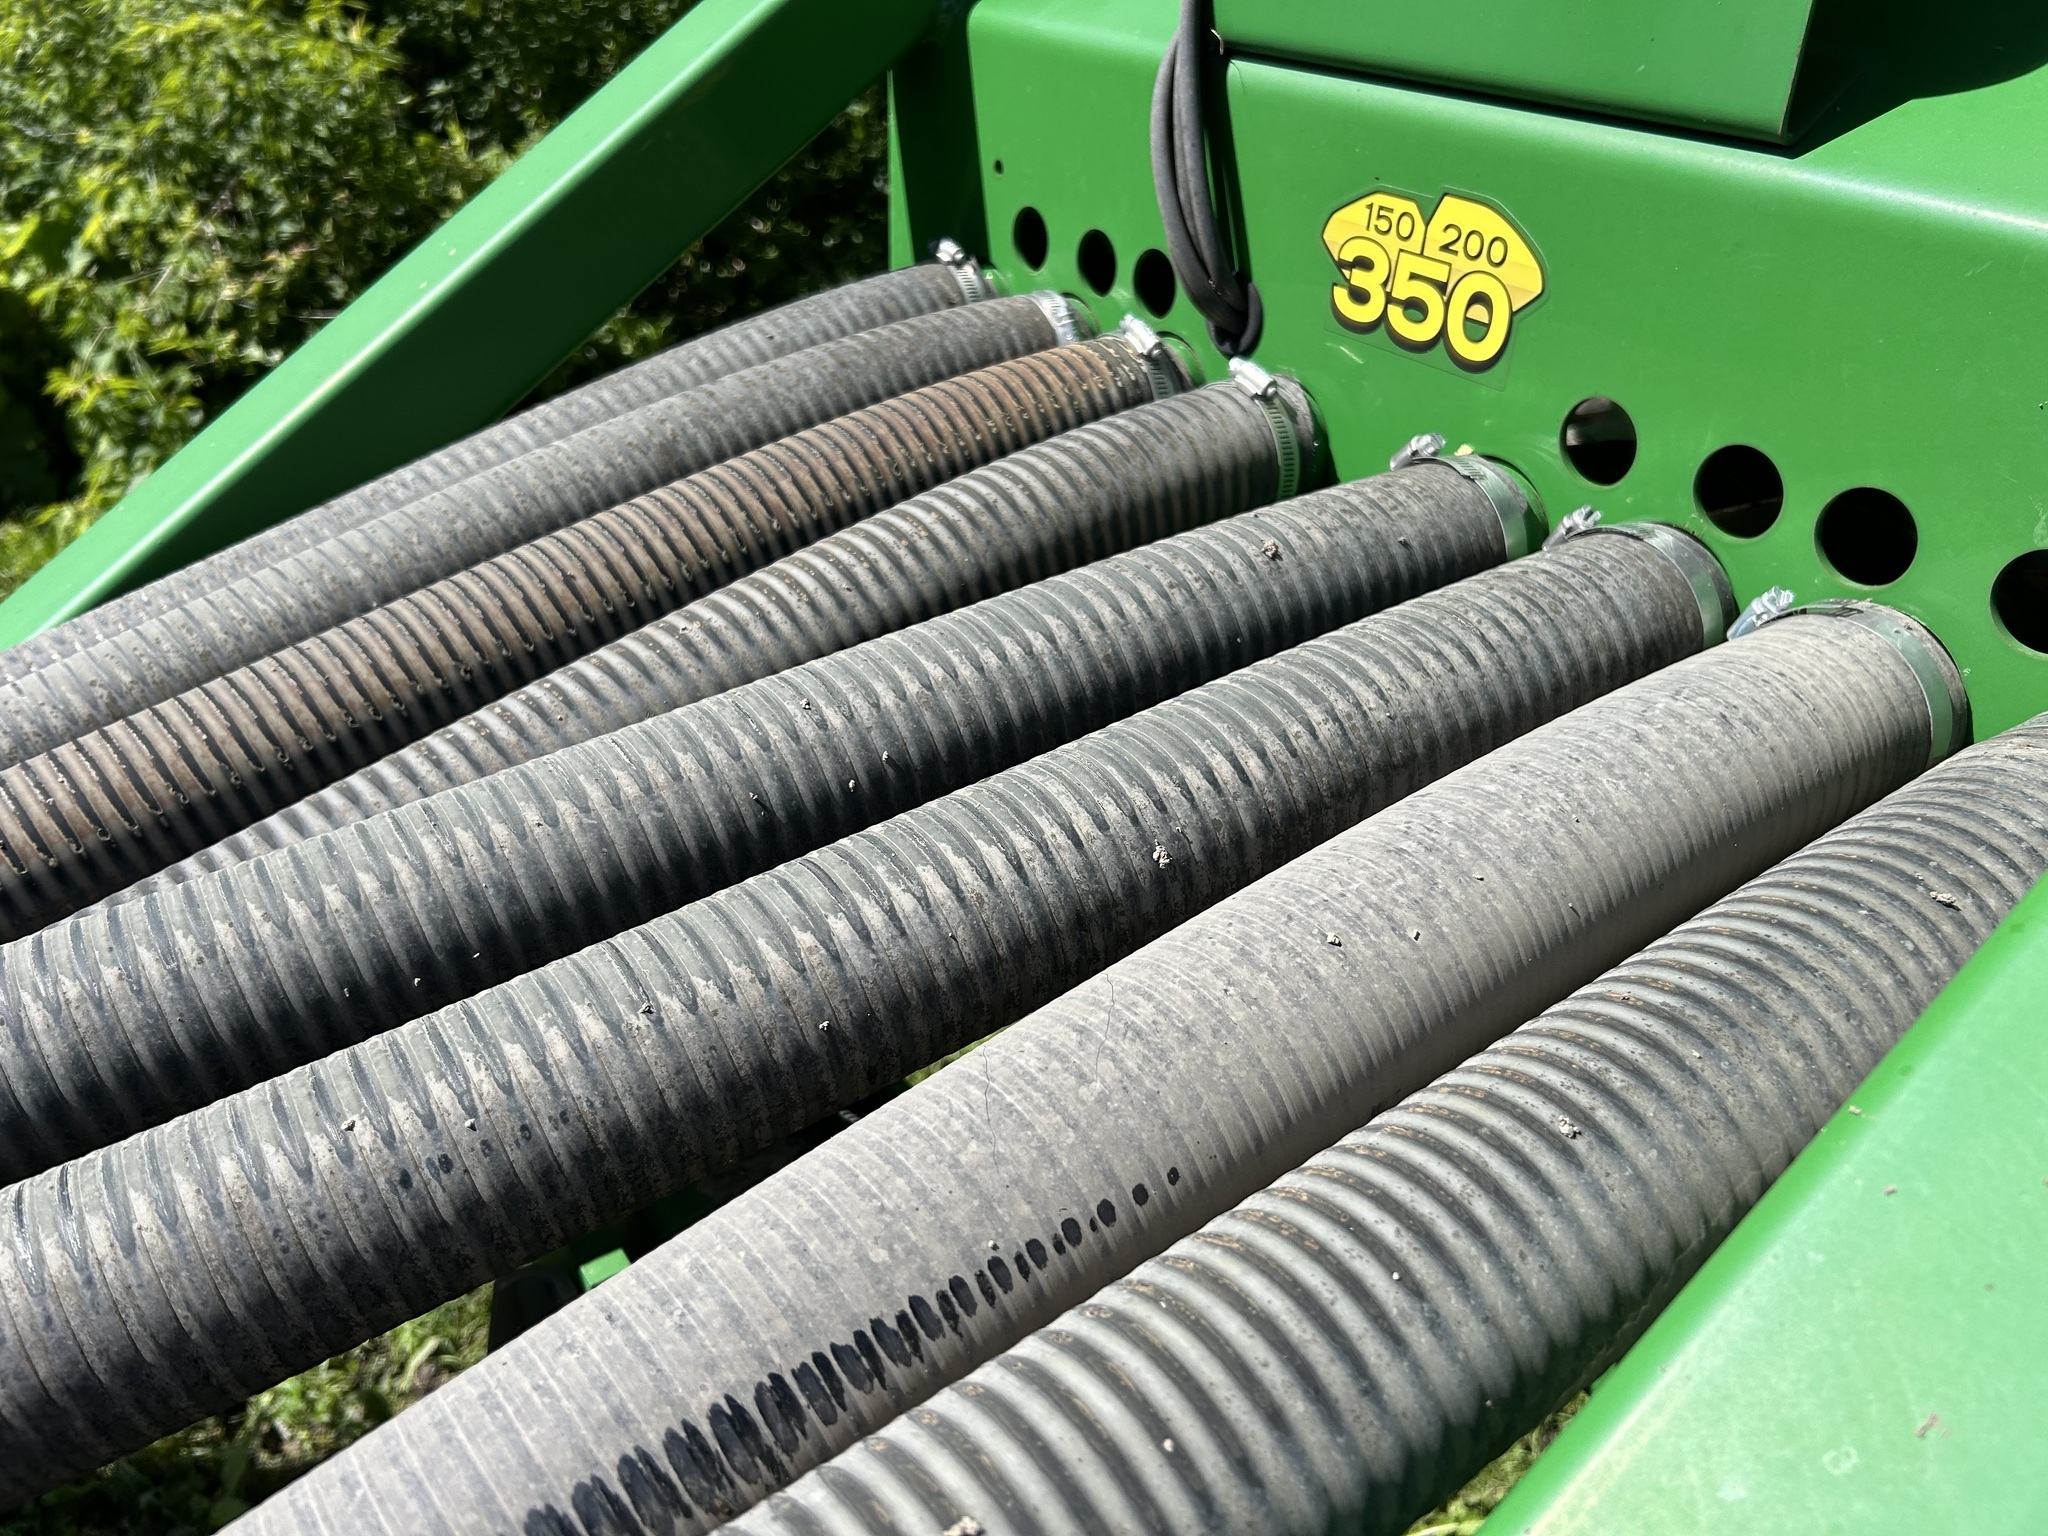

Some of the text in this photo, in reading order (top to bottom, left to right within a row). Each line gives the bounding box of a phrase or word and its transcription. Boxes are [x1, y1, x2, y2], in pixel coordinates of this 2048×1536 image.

[1365, 202, 1509, 268] 150 200
[1332, 236, 1513, 368] 350
